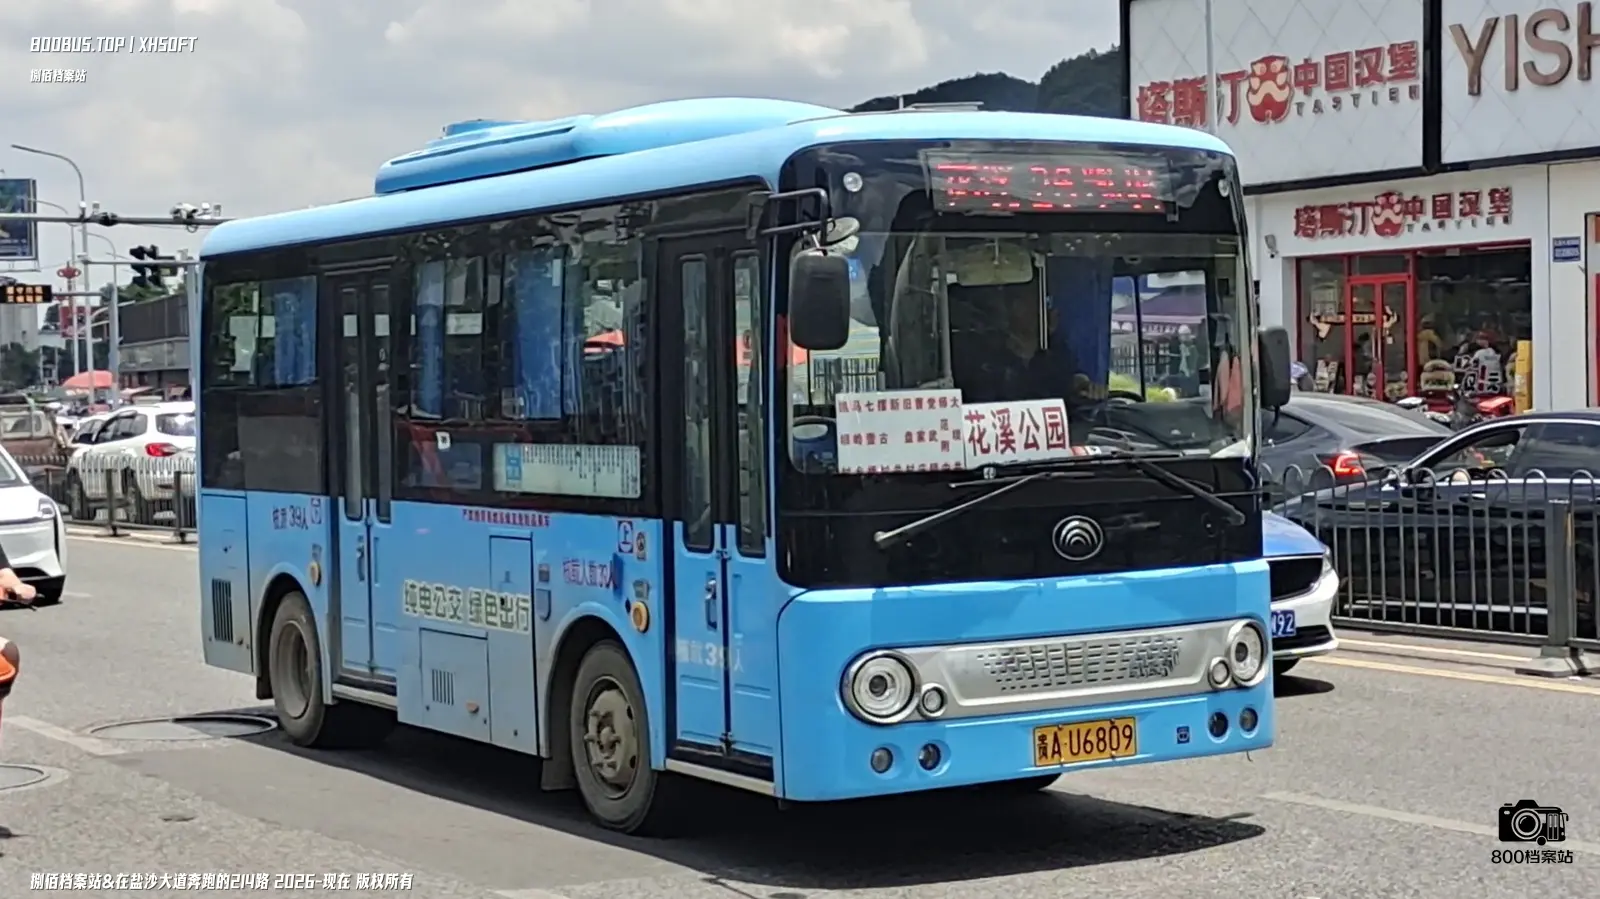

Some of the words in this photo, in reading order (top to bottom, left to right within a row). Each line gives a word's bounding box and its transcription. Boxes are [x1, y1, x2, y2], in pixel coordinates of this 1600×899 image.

[1137, 70, 1248, 126] 塔斯汀
[1294, 40, 1419, 97] 中国汉堡
[1294, 200, 1374, 239] 塔斯汀
[1403, 186, 1513, 222] 中国汉堡
[964, 405, 1068, 457] 花溪公园
[405, 579, 463, 621] 纯电公交
[469, 588, 530, 632] 绿色出行
